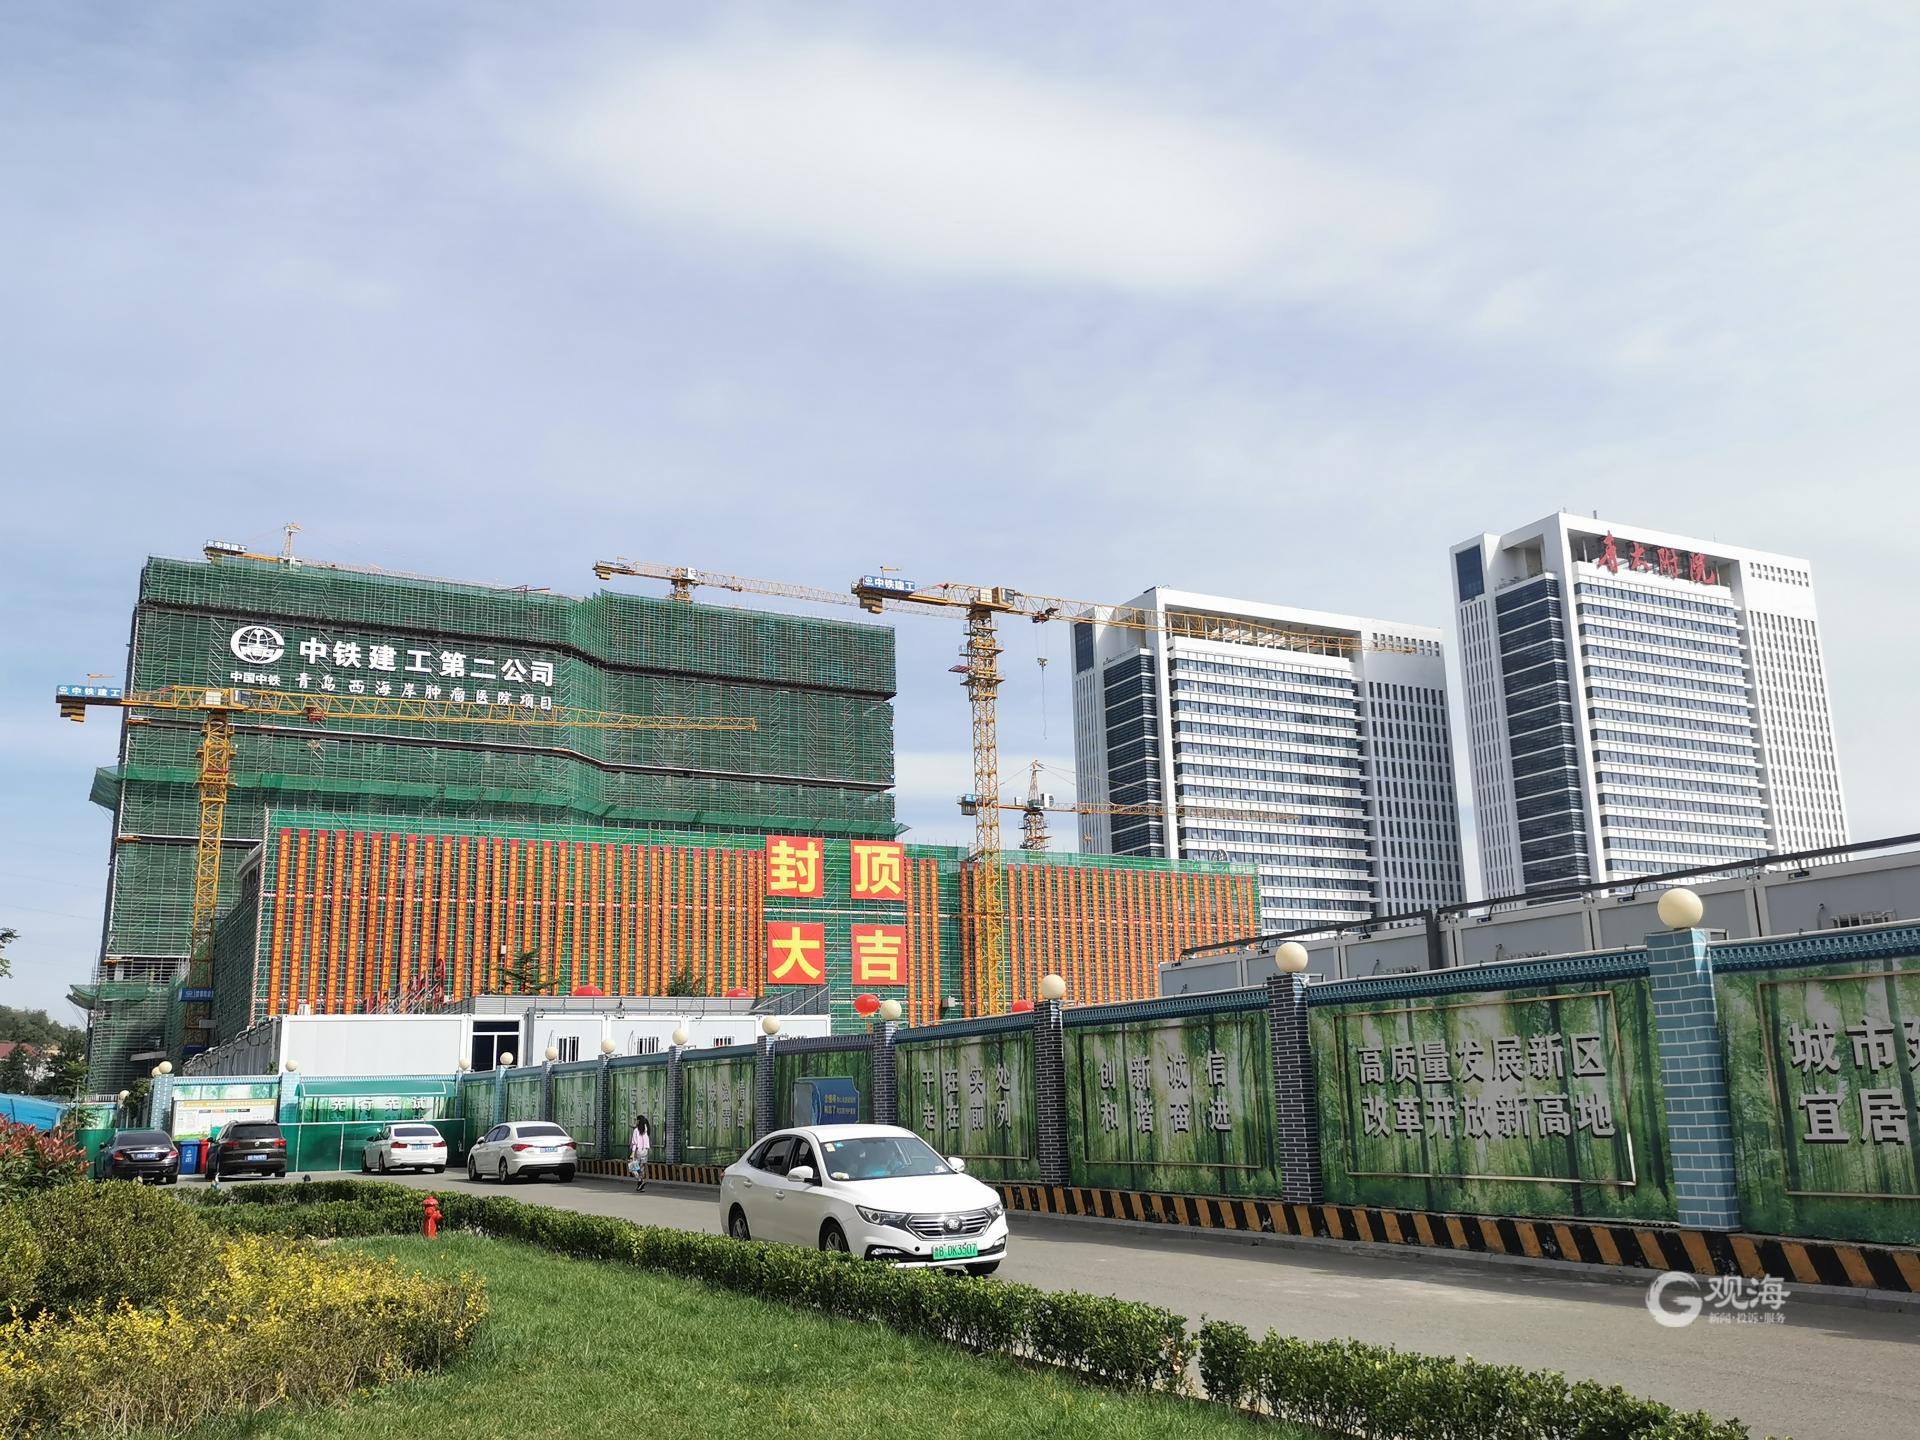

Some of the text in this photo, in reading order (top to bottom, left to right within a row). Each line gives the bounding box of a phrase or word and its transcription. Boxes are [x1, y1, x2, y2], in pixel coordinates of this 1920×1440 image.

[874, 578, 914, 591] 中铁建工
[230, 671, 281, 686] 中国中铁
[300, 637, 554, 687] 中铁建工第二公司
[71, 687, 120, 697] 中铁建工
[295, 672, 552, 711] 青岛西海岸肿瘤医院项目
[769, 840, 901, 895] 封顶
[772, 926, 902, 981] 大吉
[1099, 1049, 1226, 1090] 创新诚信
[1357, 1032, 1607, 1086] 高质量发展新区
[922, 1062, 1011, 1096] 干在实处
[331, 1097, 426, 1112] 先行先试
[922, 1099, 1012, 1131] 走在前列
[1100, 1097, 1232, 1133] 和谐奋进
[1361, 1091, 1616, 1139] 改革开放新高地
